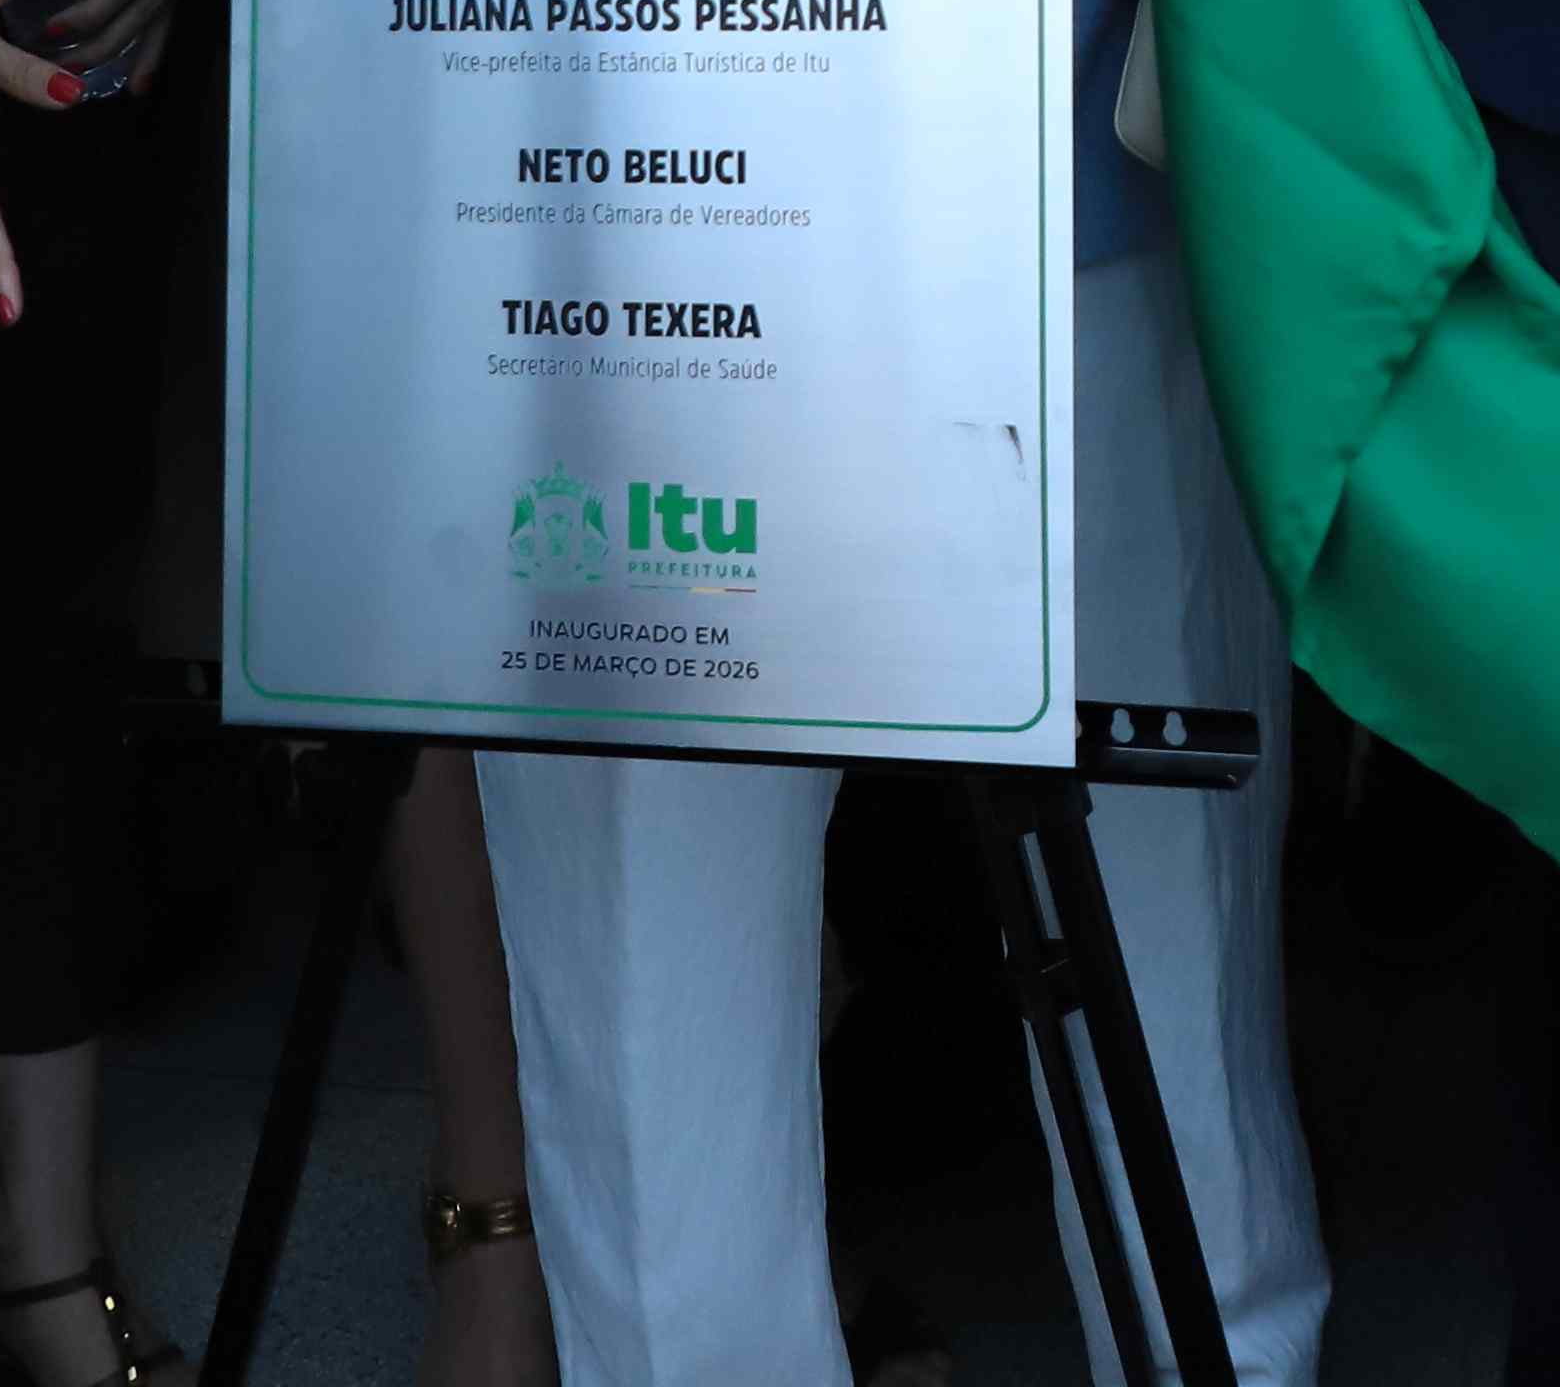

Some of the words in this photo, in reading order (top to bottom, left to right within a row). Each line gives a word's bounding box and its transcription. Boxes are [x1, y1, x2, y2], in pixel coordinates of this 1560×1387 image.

[441, 49, 563, 77] Vice-prefeita
[567, 49, 593, 74] da
[596, 50, 679, 74] Estância
[770, 49, 798, 74] de
[802, 51, 831, 75] Itu
[517, 147, 611, 185] NETO
[623, 148, 747, 186] BELUCI
[455, 200, 558, 225] Presidente
[562, 202, 586, 226] da
[591, 202, 664, 227] Câmara
[668, 201, 695, 227] de
[699, 203, 812, 228] Vereadores
[500, 298, 610, 338] TIAGO
[621, 301, 763, 340] TEXERA
[588, 355, 681, 384] Municipal
[685, 356, 712, 381] de
[716, 357, 779, 381] Saúde
[627, 481, 759, 556] Itu
[627, 560, 759, 581] PREFEITURA
[528, 619, 689, 645] INAUGURADO
[693, 625, 731, 647] EM
[500, 649, 529, 671] 25
[534, 650, 567, 673] DE
[572, 653, 658, 680] MARÇO
[663, 656, 698, 679] DE
[702, 658, 761, 682] 2026
